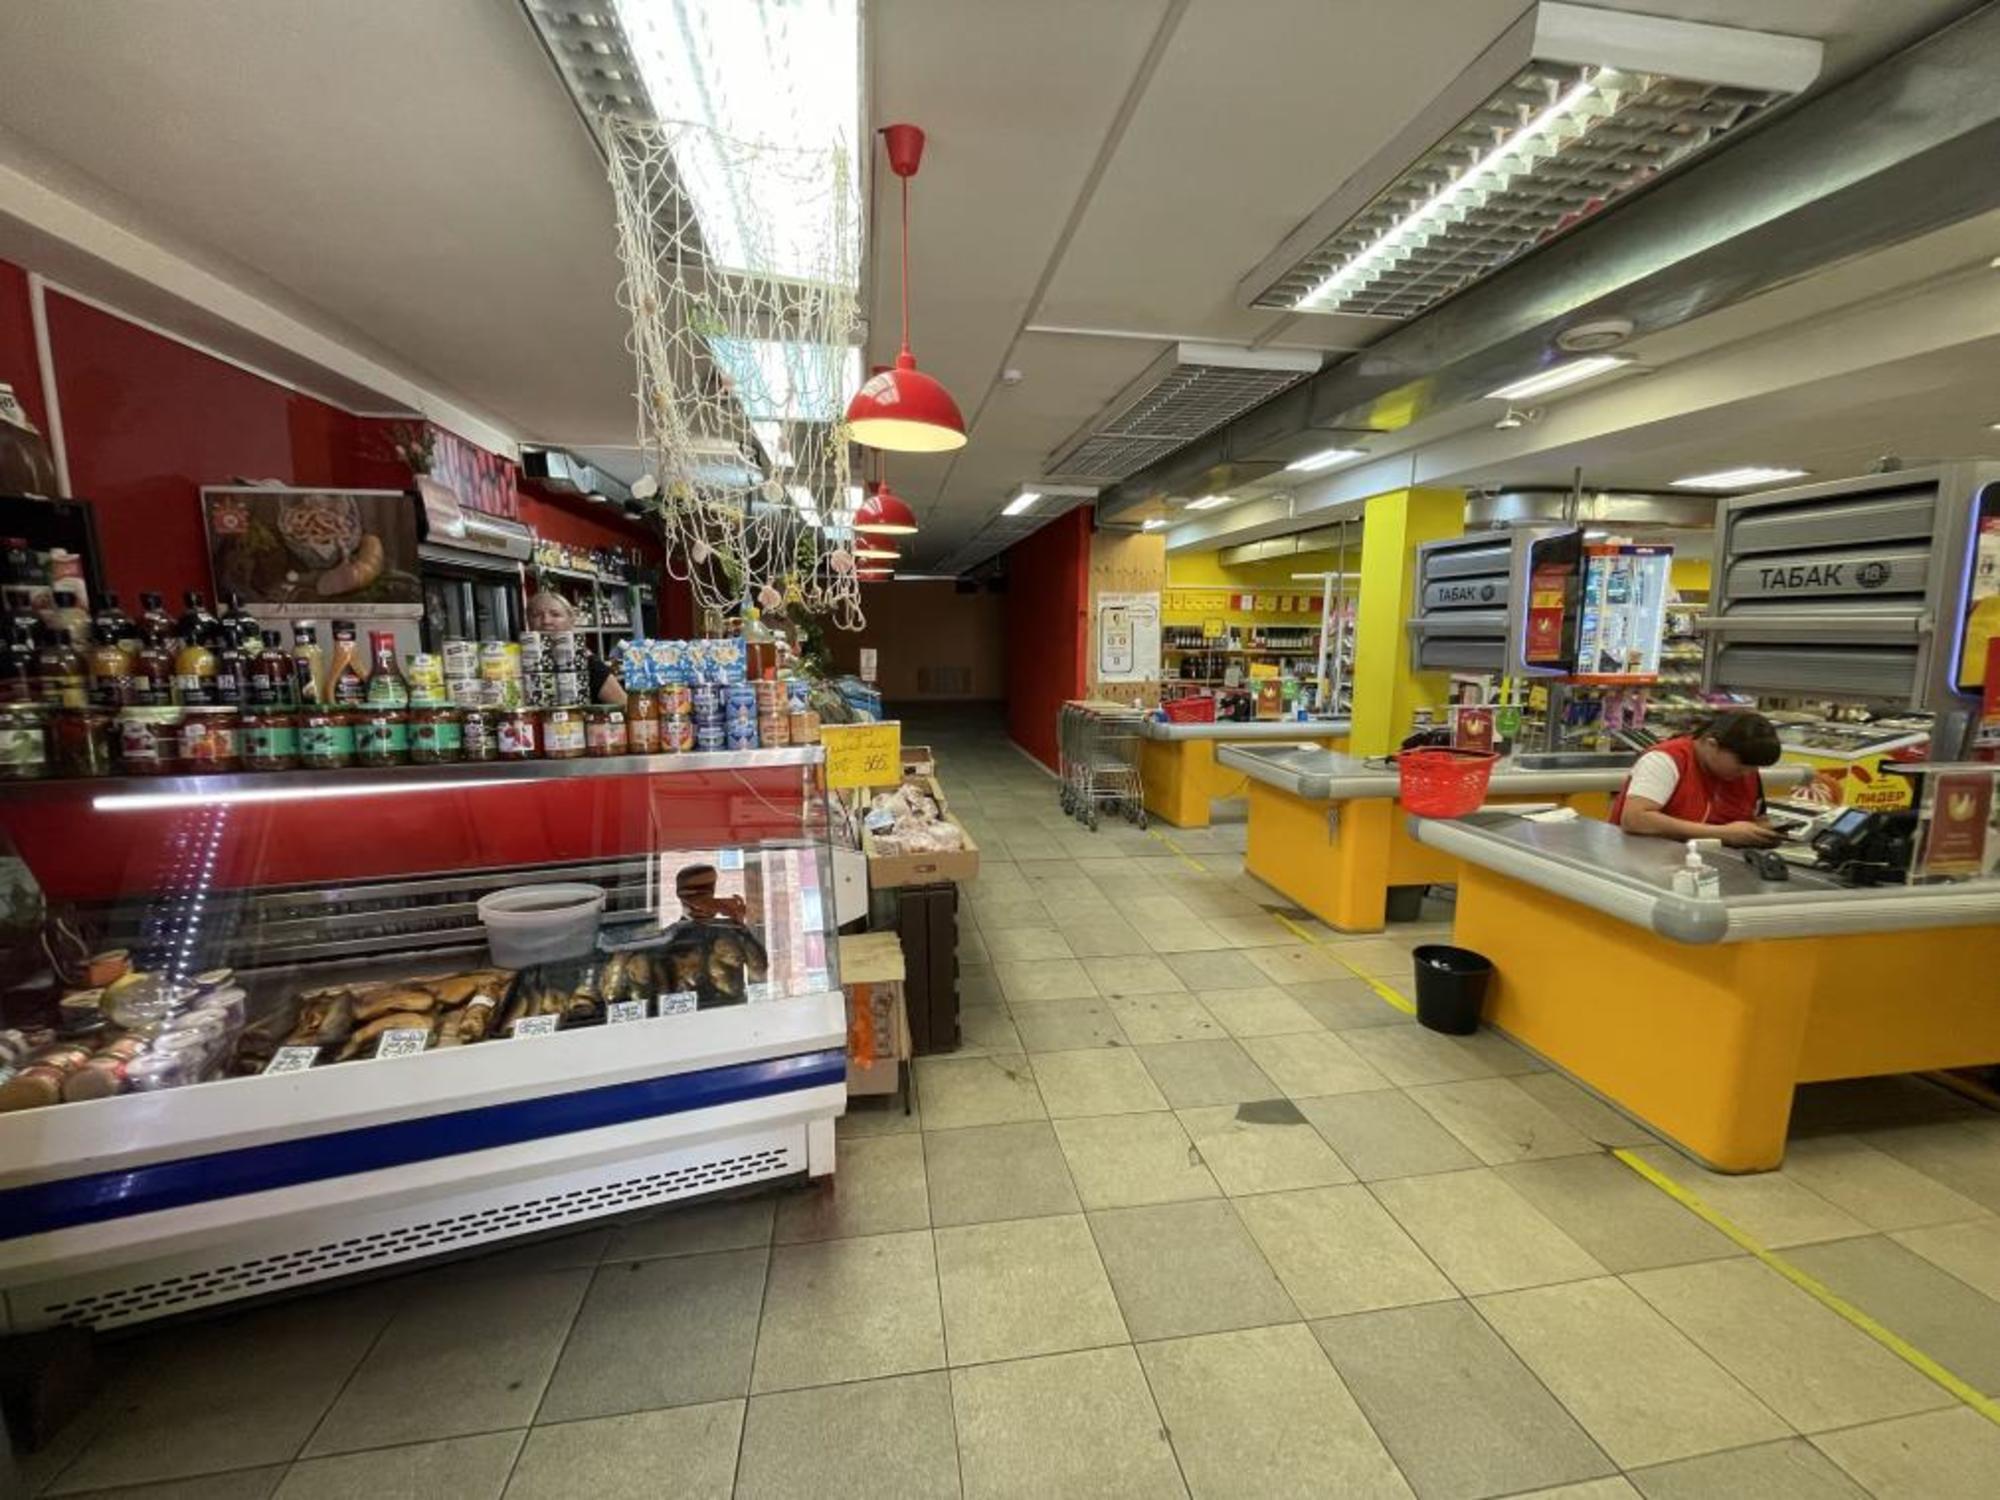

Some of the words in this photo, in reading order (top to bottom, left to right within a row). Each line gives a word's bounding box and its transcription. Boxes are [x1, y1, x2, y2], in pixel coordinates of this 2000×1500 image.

[1760, 564, 1843, 588] ТАБАК
[1439, 586, 1477, 600] ТАБАК
[1855, 791, 1905, 804] ЛИДЕР
